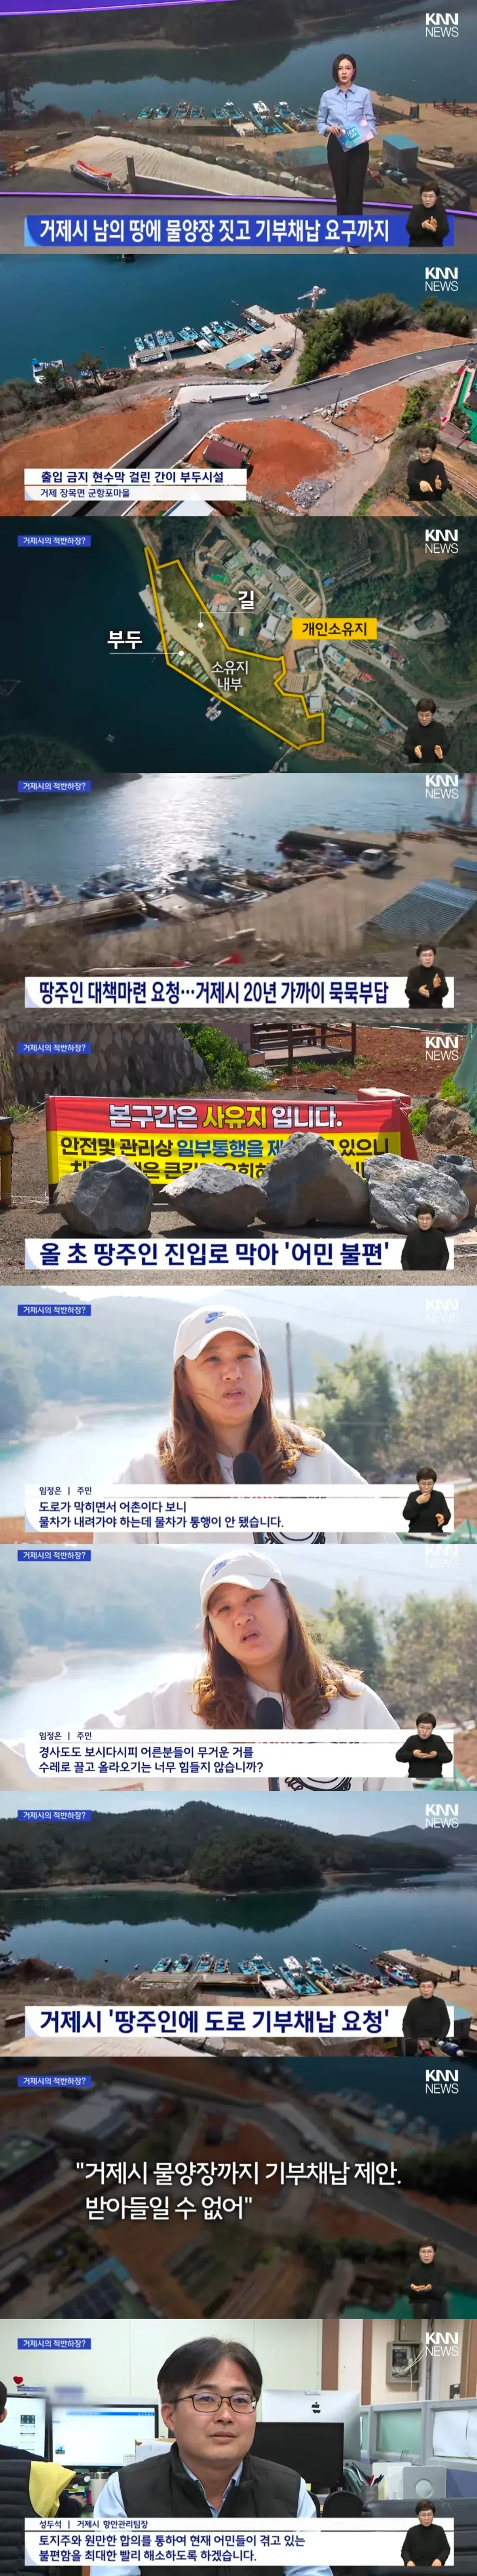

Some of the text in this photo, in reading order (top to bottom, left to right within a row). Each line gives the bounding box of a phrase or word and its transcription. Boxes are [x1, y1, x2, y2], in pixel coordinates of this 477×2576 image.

[109, 1103, 343, 1129] 본구간은 사유지 입니다.
[61, 1137, 116, 1156] 안전및
[120, 1138, 173, 1157] 관리상
[177, 1139, 264, 1158] 일부통행을
[339, 1138, 389, 1157] 있으니
